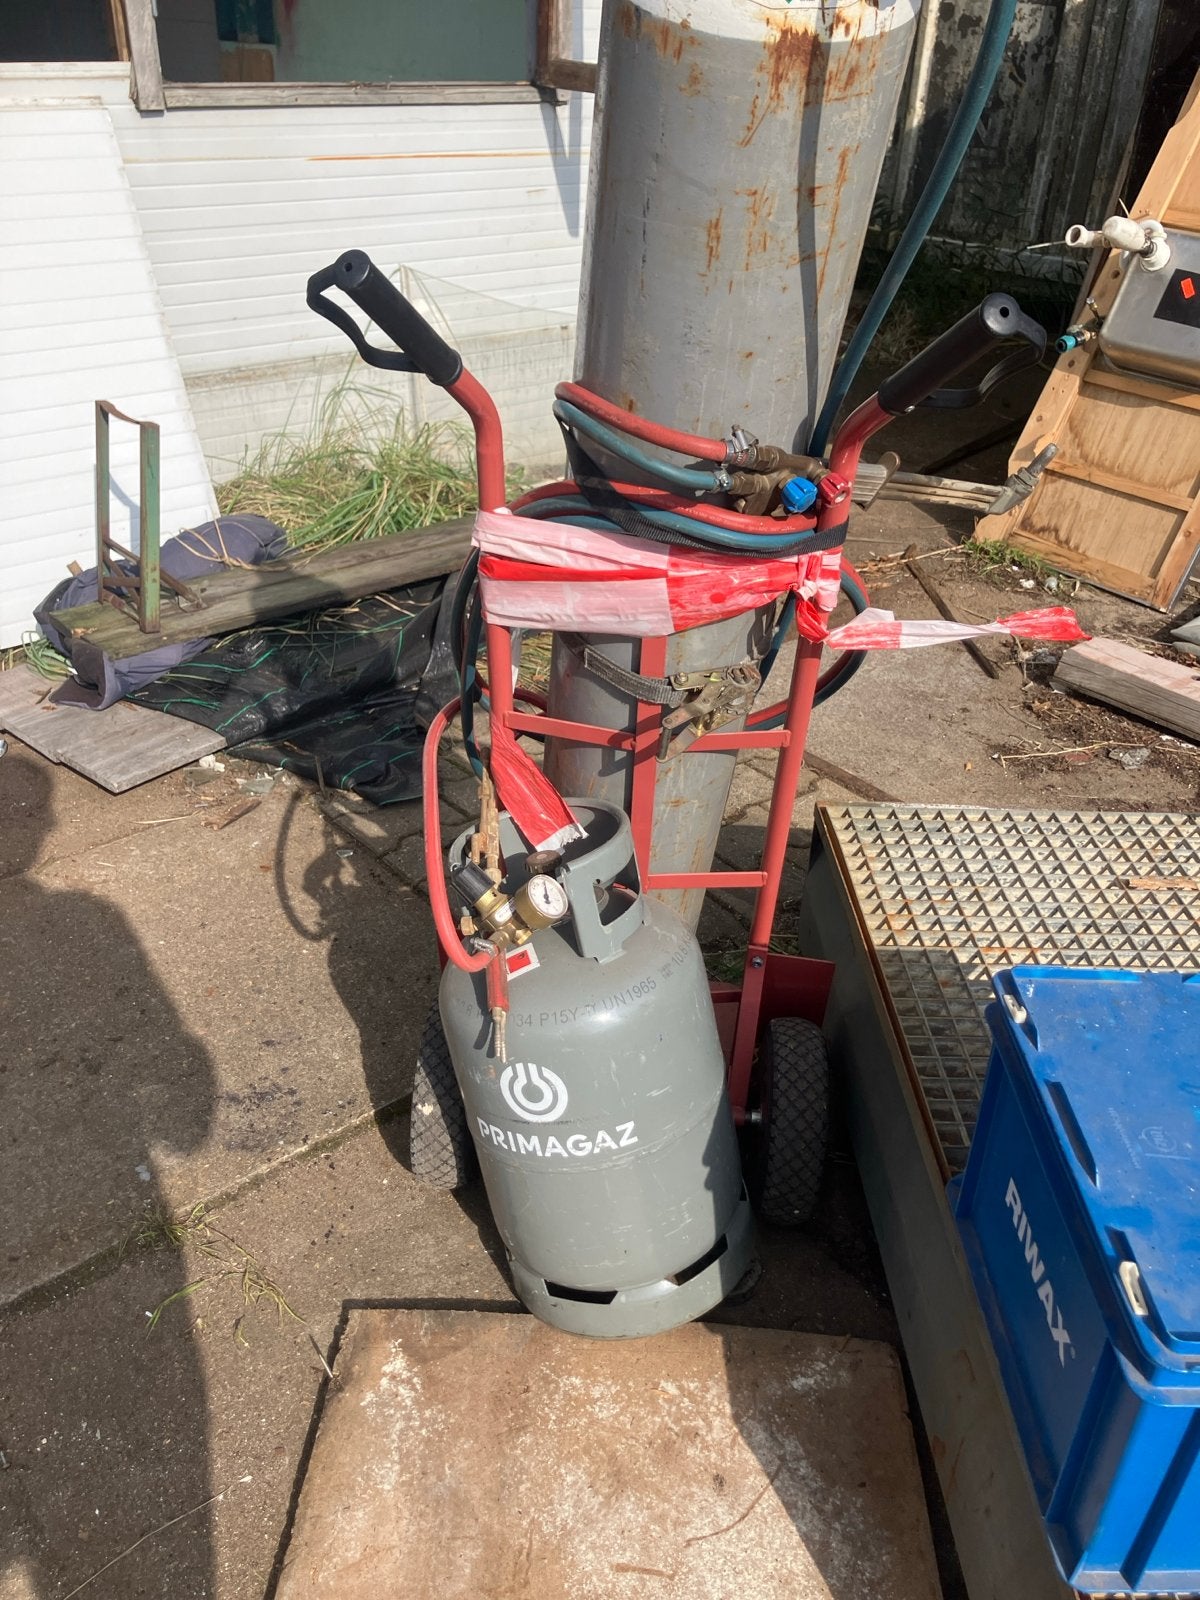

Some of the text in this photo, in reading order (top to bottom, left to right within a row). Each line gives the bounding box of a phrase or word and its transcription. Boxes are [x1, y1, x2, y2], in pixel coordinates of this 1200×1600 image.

[601, 976, 657, 1013] UN1965
[477, 1116, 639, 1157] PRIMAGAZ
[1005, 1177, 1071, 1368] RIWAX
